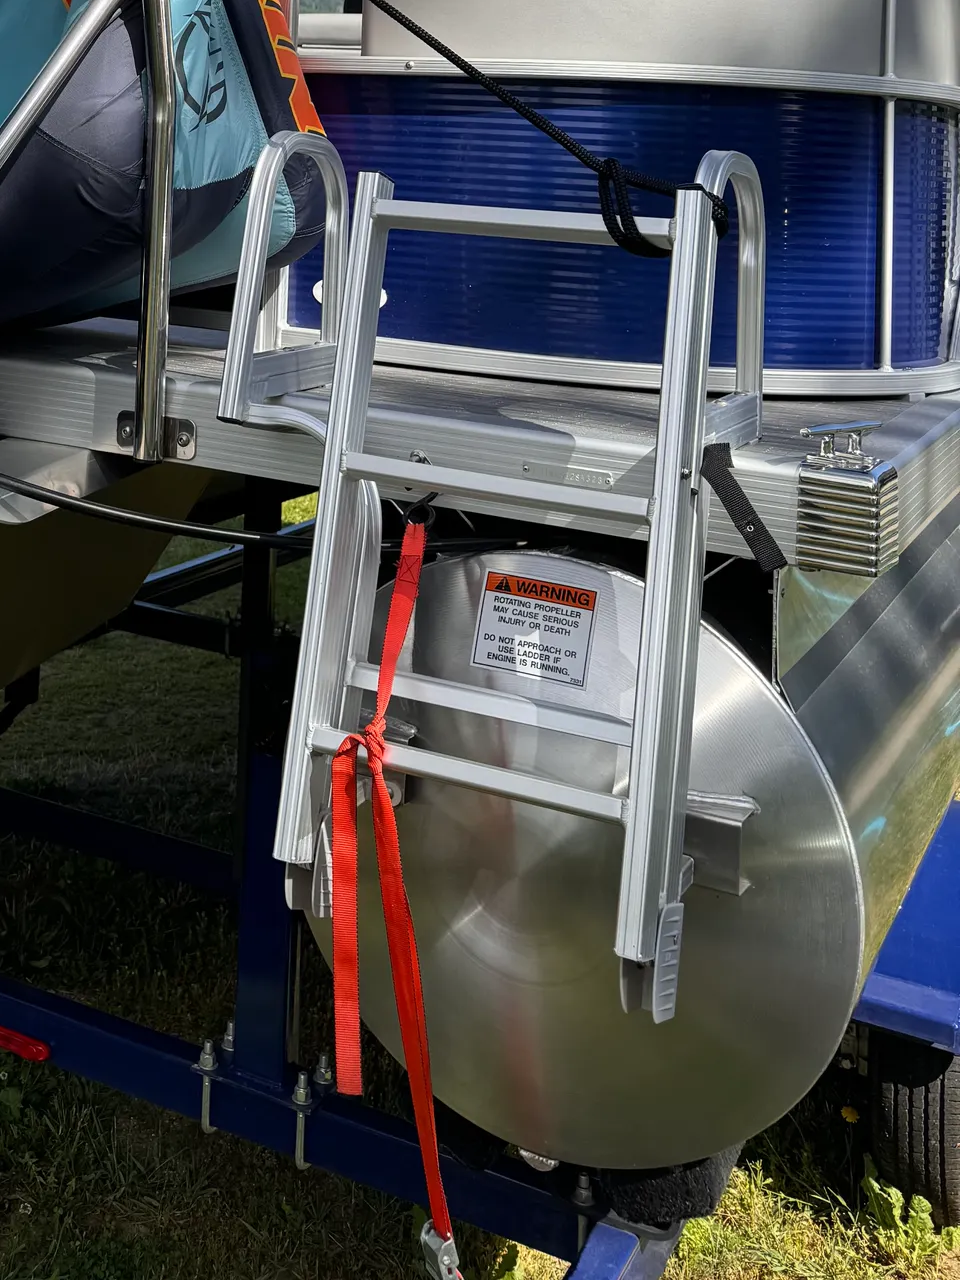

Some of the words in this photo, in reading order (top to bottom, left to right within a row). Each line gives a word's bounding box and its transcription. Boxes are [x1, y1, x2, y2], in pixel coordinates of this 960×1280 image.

[516, 580, 590, 606] WARNING
[493, 605, 509, 613] MAY
[512, 609, 539, 619] CAUSE
[542, 615, 579, 628] SERIOUS
[494, 596, 531, 608] ROTATING
[534, 604, 581, 619] PROPELLER
[498, 616, 526, 626] INJURY
[529, 622, 541, 630] OR
[544, 624, 571, 636] DEATH
[484, 633, 495, 641] DO
[498, 636, 515, 645] NOT
[517, 640, 561, 655] APPROACH
[564, 650, 577, 658] OR
[498, 645, 514, 654] USE
[517, 649, 550, 662] LADDER
[487, 652, 516, 664] ENGINE
[531, 661, 570, 676] RUNNING.
